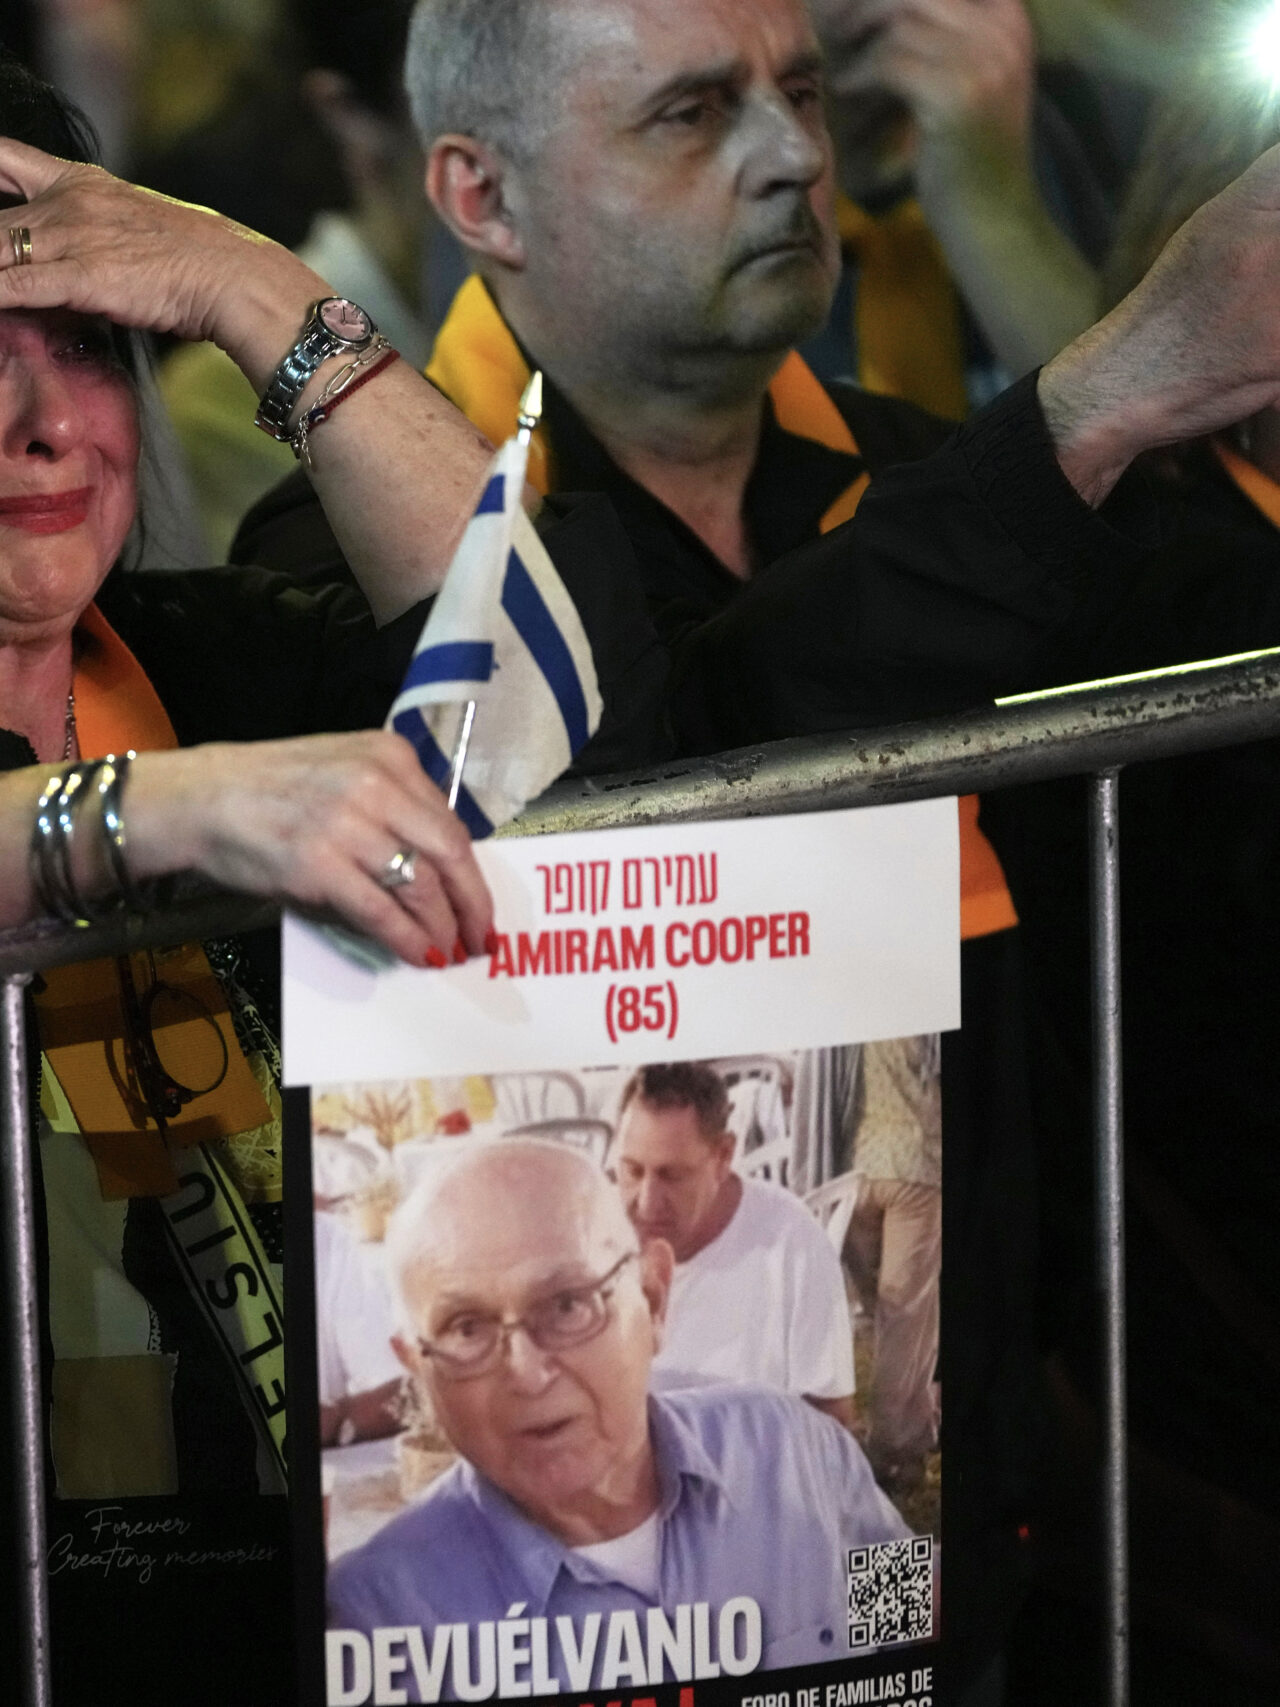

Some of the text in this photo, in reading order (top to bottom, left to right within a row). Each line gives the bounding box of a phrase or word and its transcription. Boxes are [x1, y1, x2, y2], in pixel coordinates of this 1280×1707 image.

[536, 851, 718, 916] עמירם קופר
[487, 911, 810, 979] AMIRAM COOPER
[605, 980, 679, 1044] (85)
[84, 1506, 192, 1544] Forever
[47, 1533, 278, 1584] Creating memories
[324, 1597, 762, 1707] DEVUÉLVANLO
[796, 1687, 820, 1707] DE
[826, 1673, 906, 1707] FAMILIAS
[911, 1667, 933, 1693] DE
